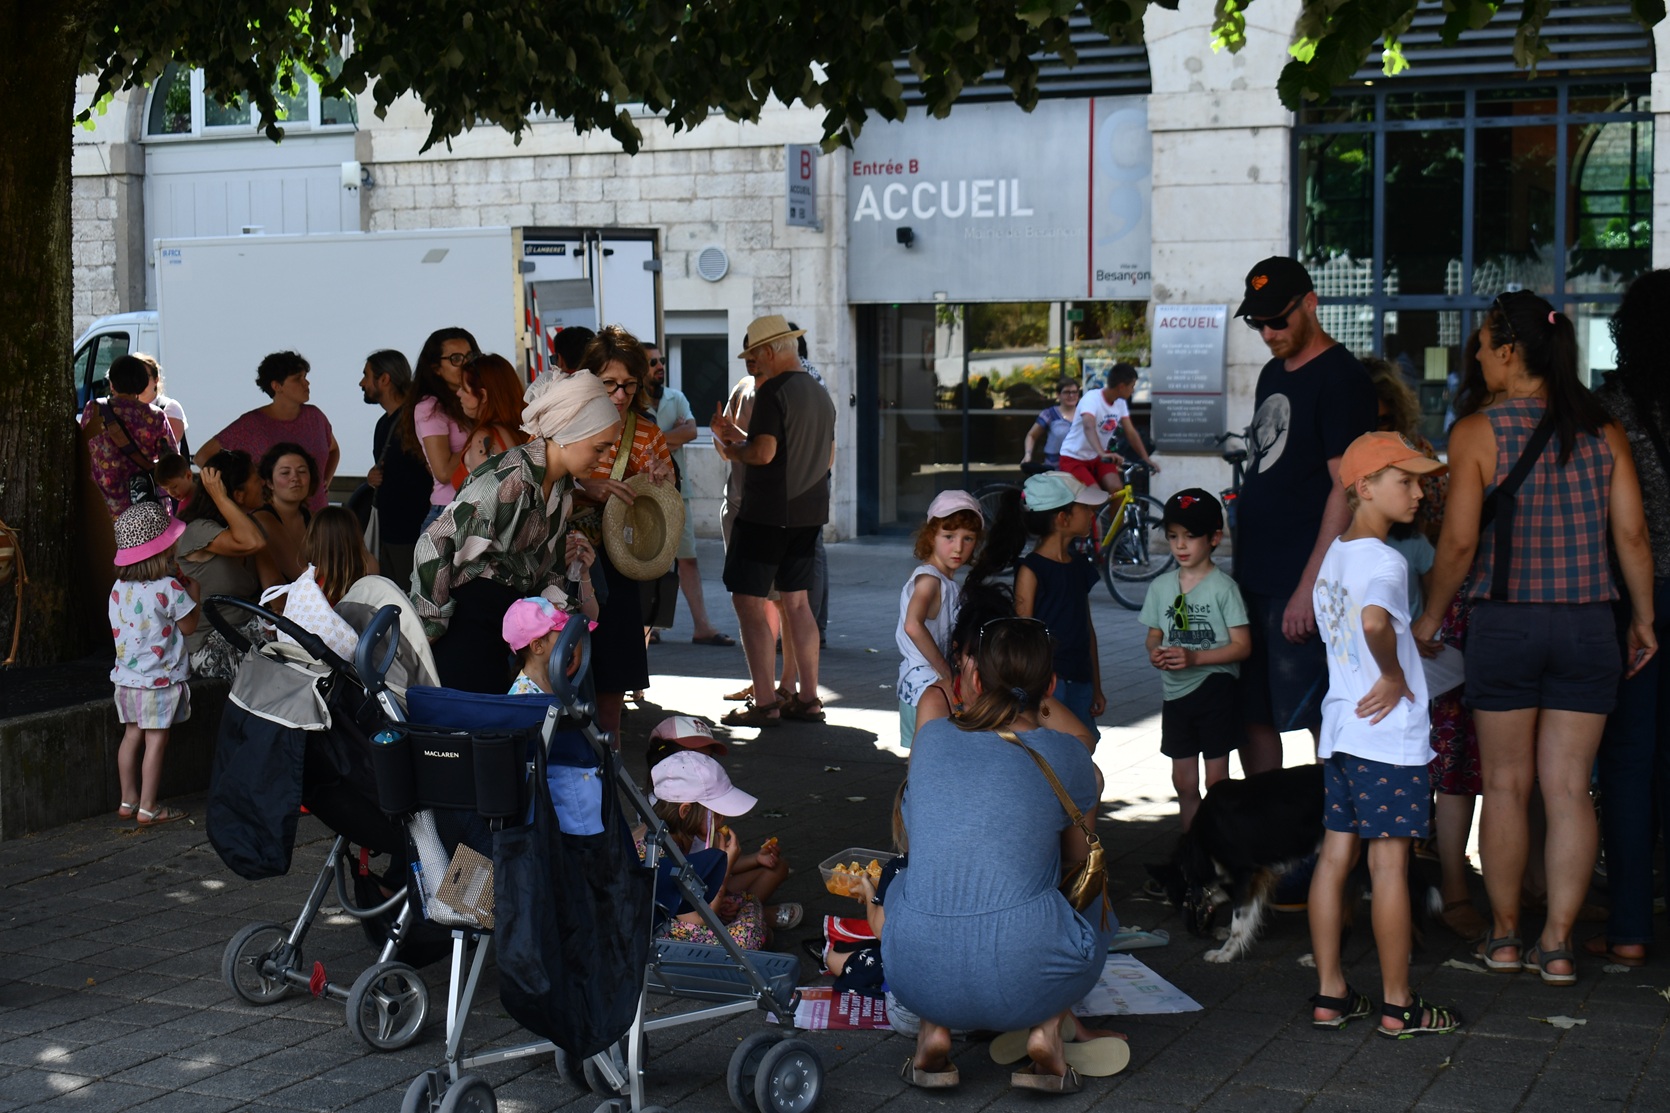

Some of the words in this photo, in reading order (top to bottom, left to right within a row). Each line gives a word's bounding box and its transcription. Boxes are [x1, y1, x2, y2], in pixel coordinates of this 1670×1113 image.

[801, 150, 811, 180] B
[852, 159, 903, 176] Entrée
[909, 159, 919, 174] B
[790, 185, 811, 195] ACCUEIL
[853, 178, 1034, 222] ACCUEIL
[1096, 269, 1151, 286] Besançon
[1160, 316, 1219, 329] ACCUEIL
[424, 750, 459, 758] MACLAREN
[773, 1060, 809, 1108] MACLAREN
